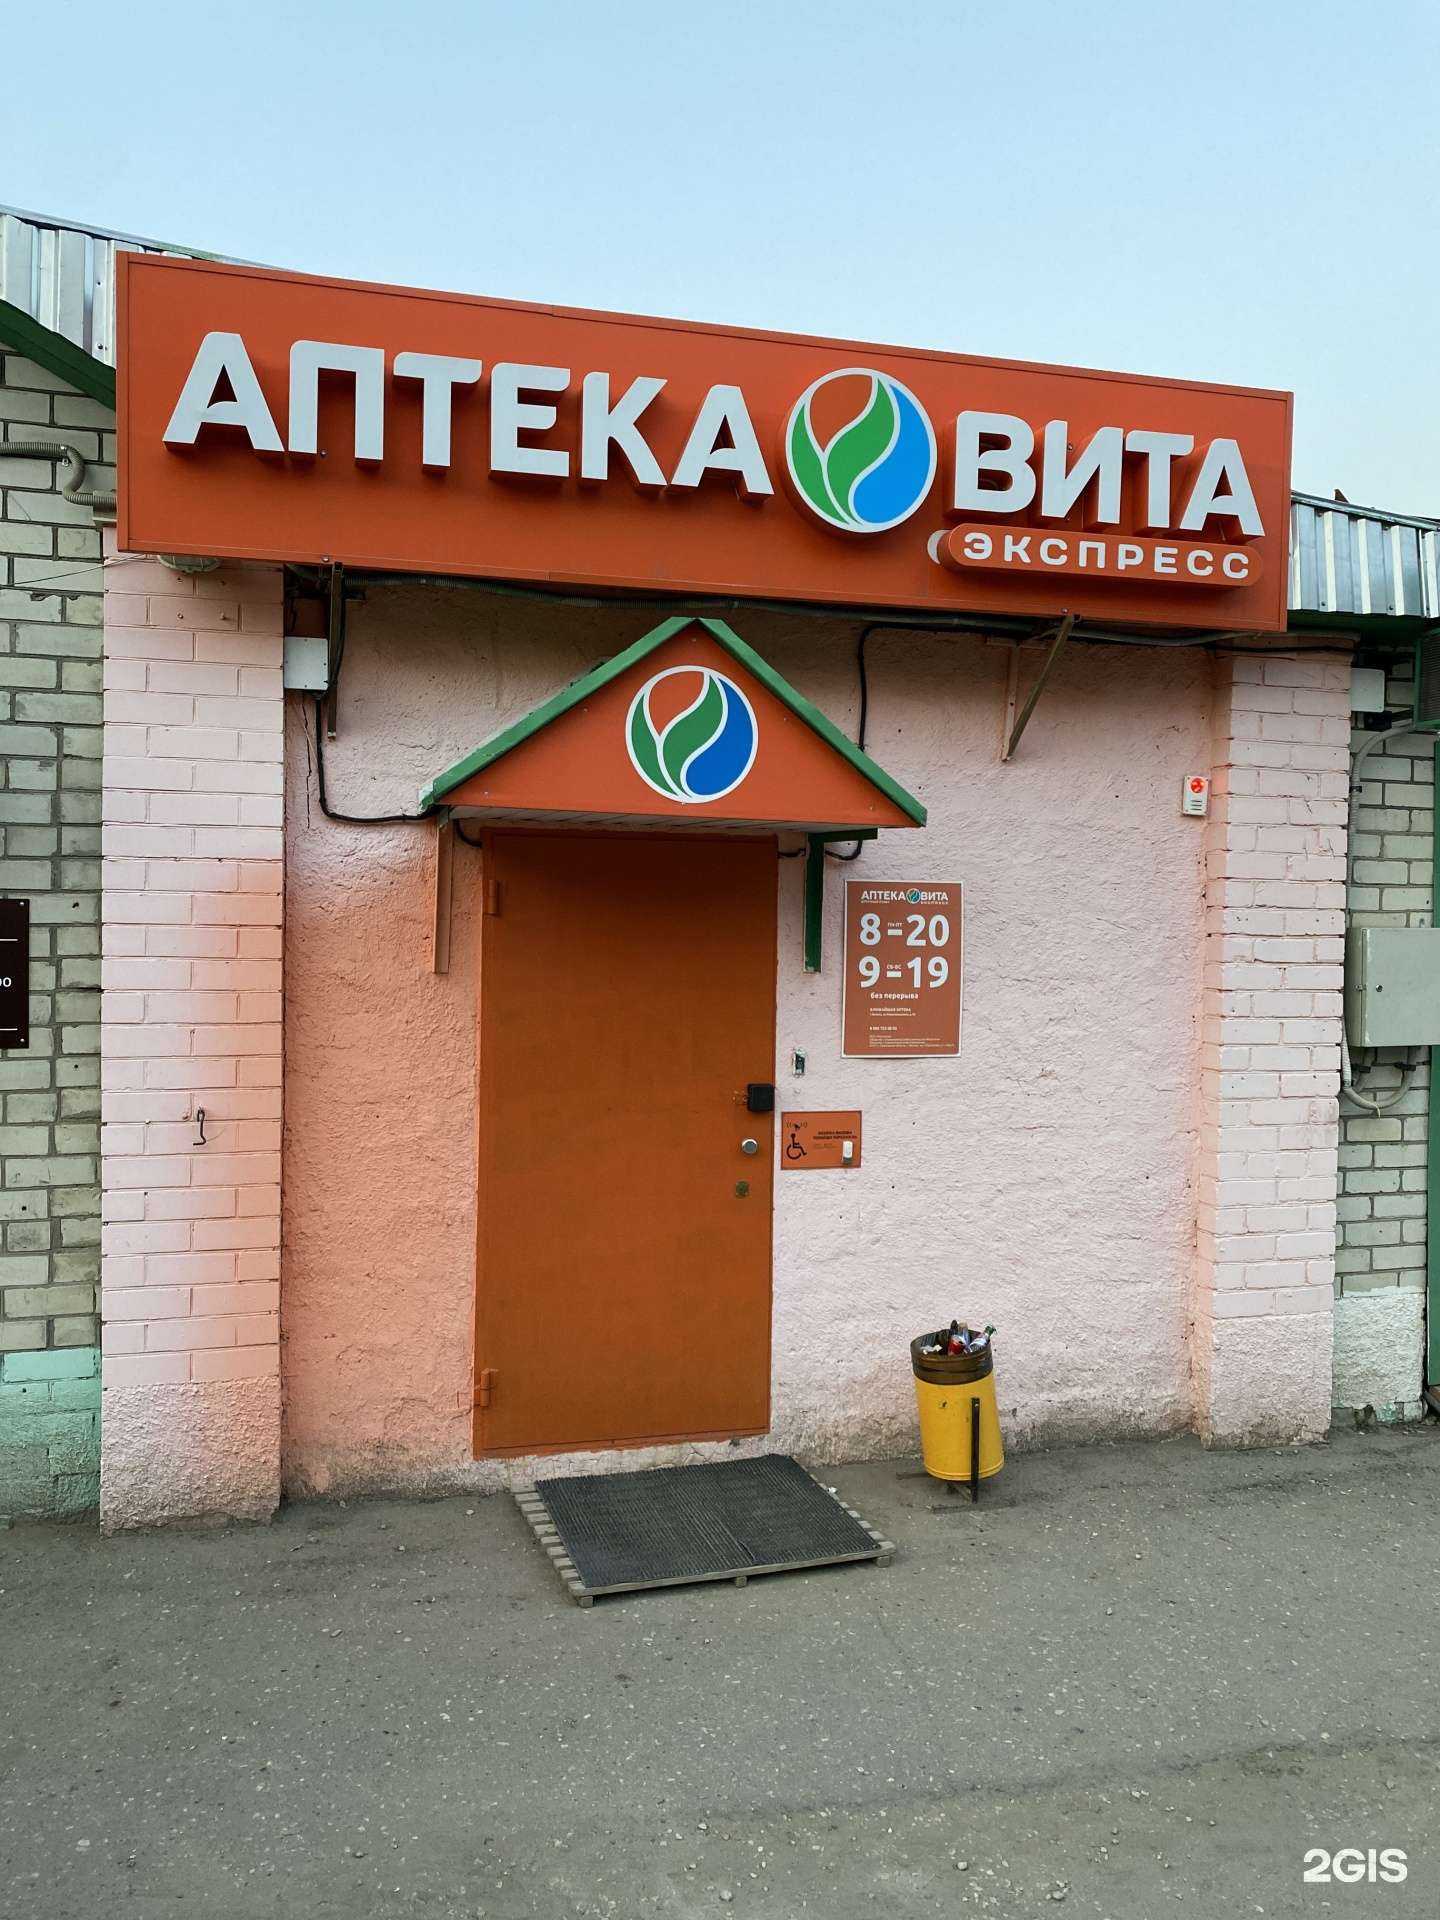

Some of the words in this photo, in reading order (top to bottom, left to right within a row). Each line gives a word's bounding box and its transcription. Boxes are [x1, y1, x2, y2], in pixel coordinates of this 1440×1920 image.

[163, 331, 774, 495] АПТЕКА
[953, 410, 1265, 536] ВИТА
[963, 531, 1249, 579] ЭКСПРЕСС
[861, 890, 906, 901] АПТЕКА
[920, 891, 949, 901] ВИТА
[870, 991, 882, 999] без
